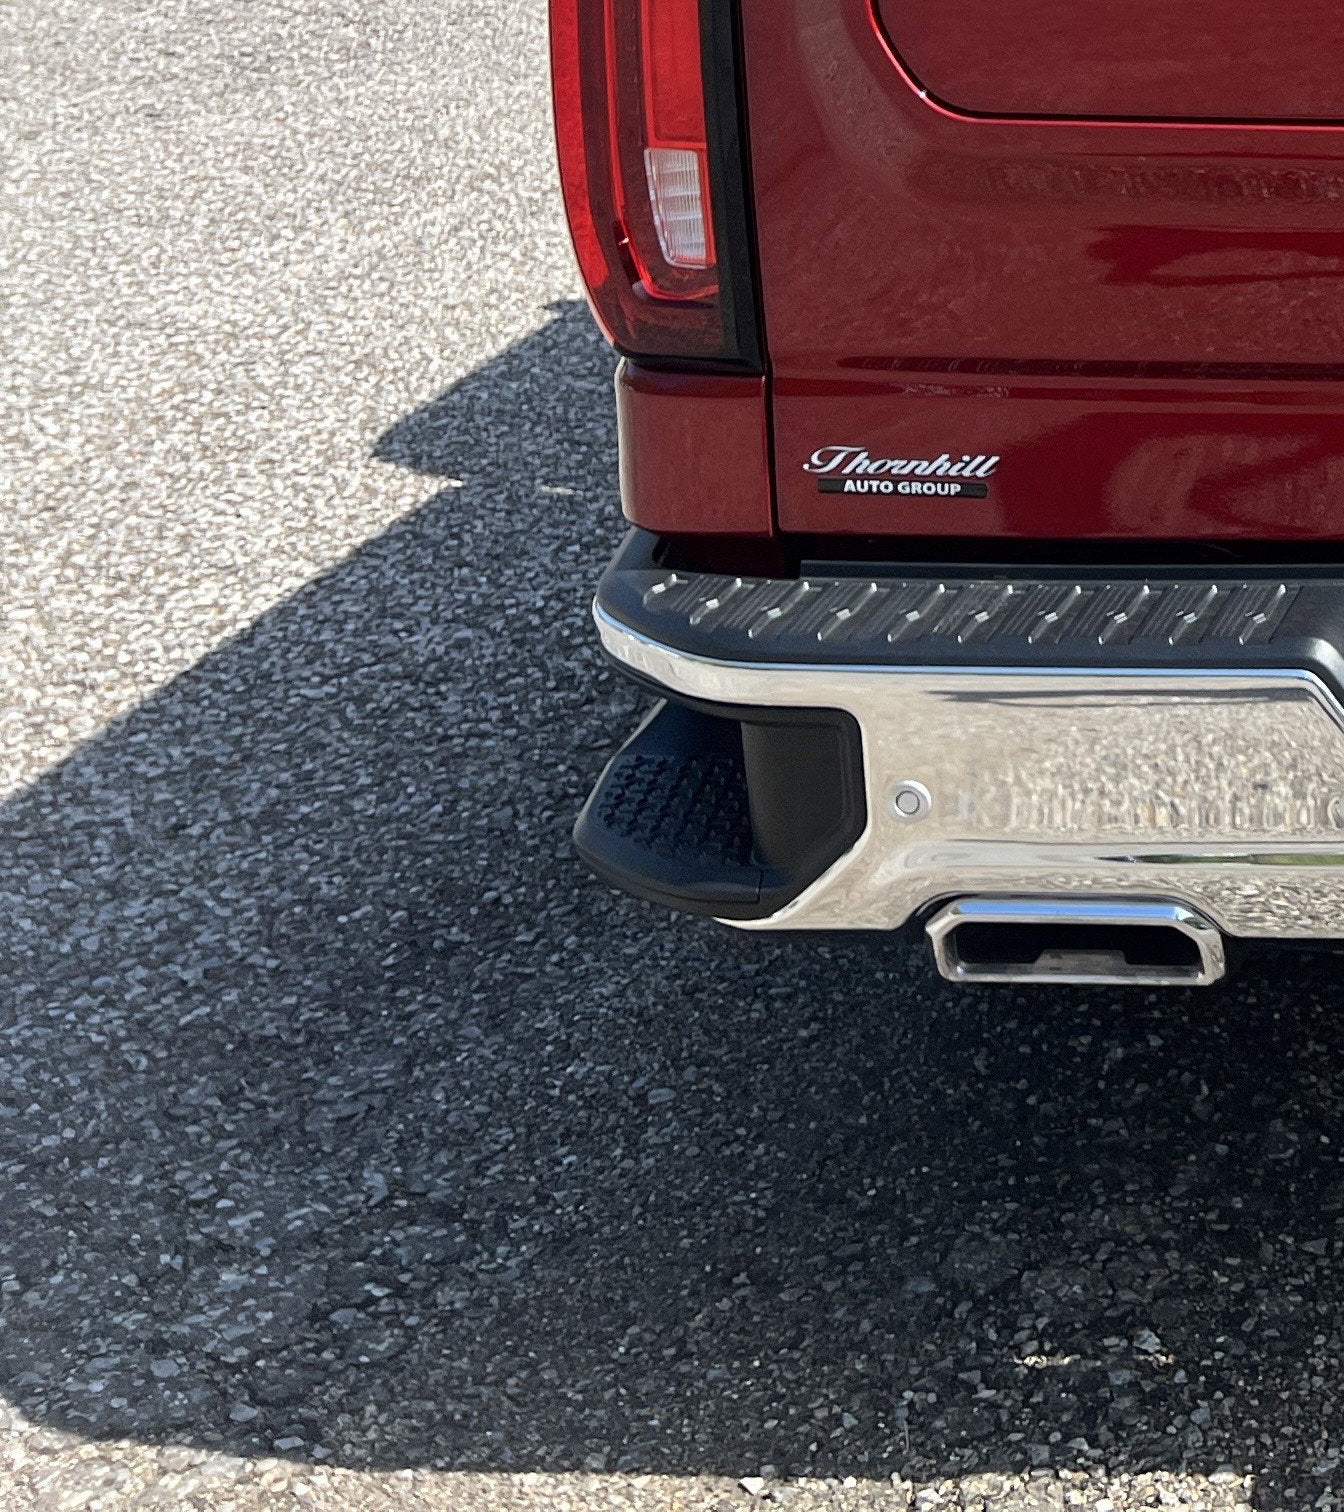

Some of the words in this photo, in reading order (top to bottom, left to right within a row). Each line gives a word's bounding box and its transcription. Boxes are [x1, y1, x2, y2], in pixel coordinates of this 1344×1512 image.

[803, 445, 1001, 479] Thornhill
[843, 479, 893, 494] AUTO
[897, 481, 962, 496] GROUP
